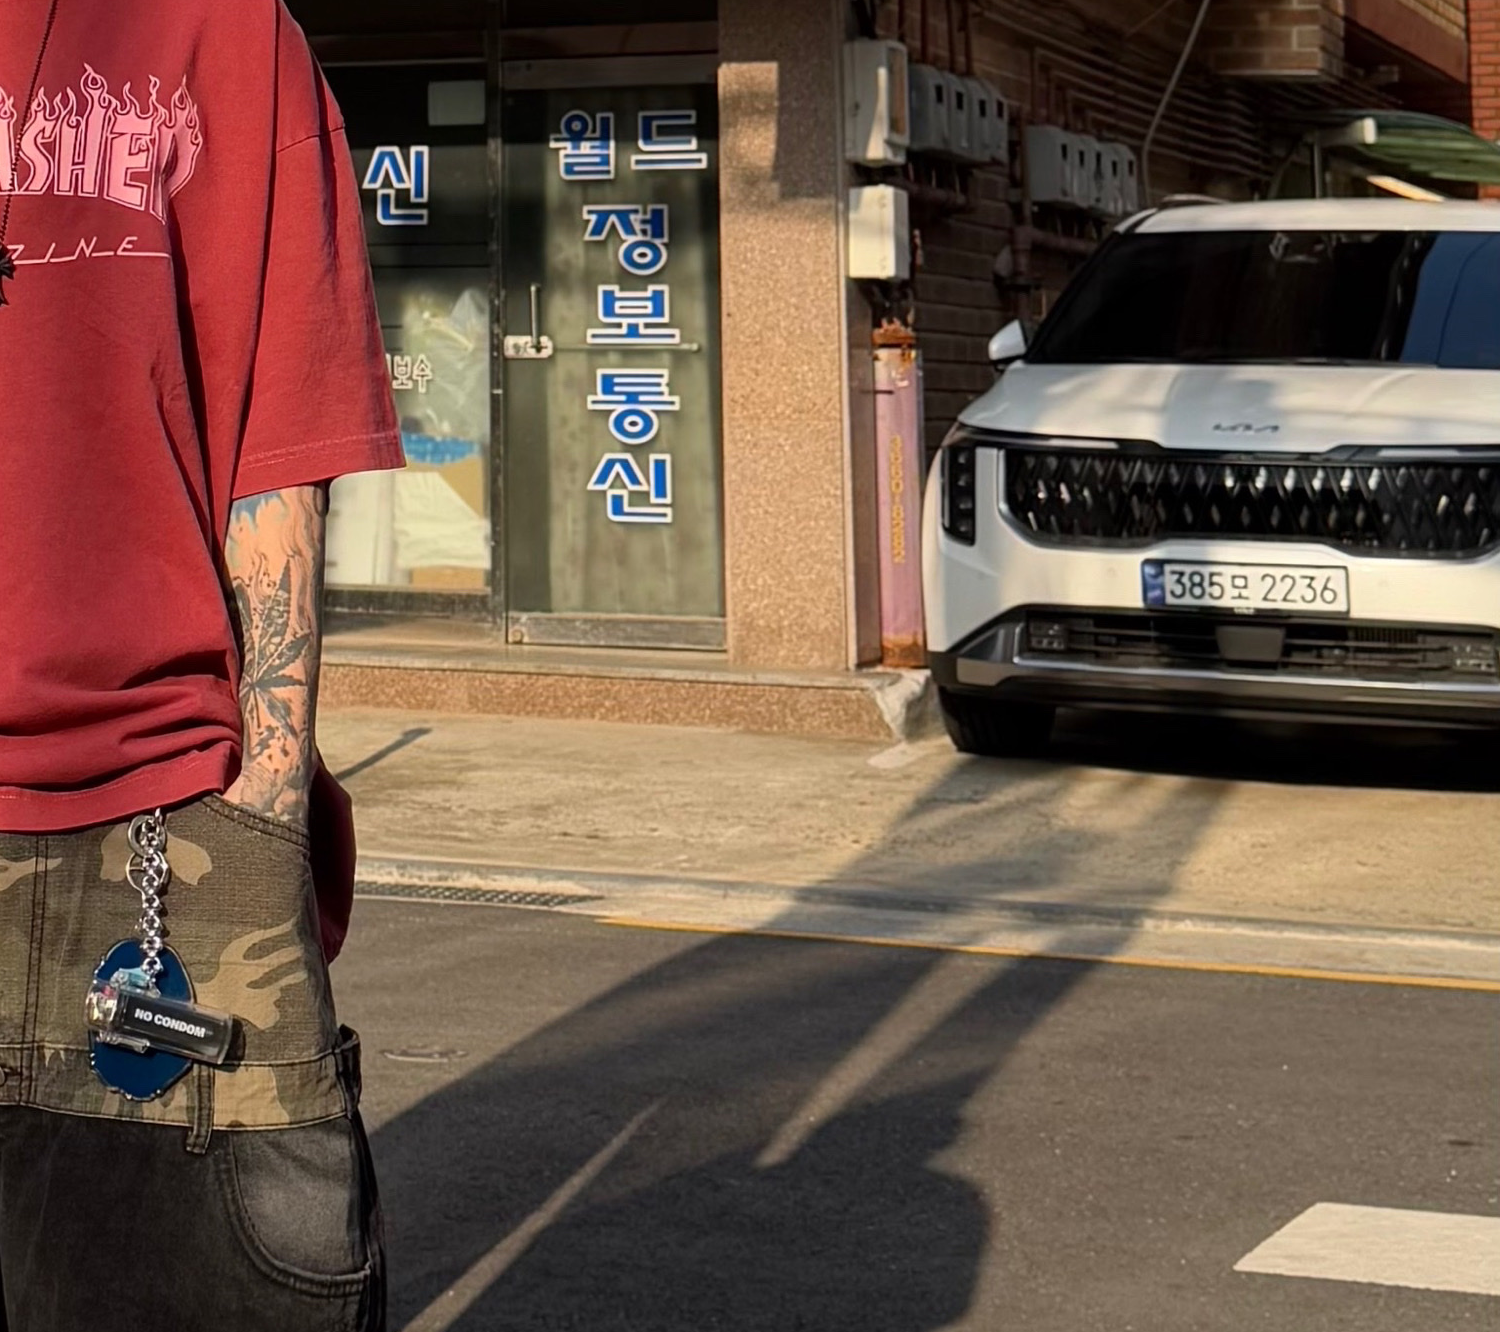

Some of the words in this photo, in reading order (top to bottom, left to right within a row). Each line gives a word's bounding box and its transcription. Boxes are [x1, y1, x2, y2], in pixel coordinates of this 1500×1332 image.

[549, 110, 707, 181] 월드
[385, 353, 433, 394] 보수
[583, 204, 680, 523] 정보통신
[1261, 573, 1338, 605] 2236
[134, 1007, 153, 1022] NO
[153, 1014, 206, 1038] CONDOM
